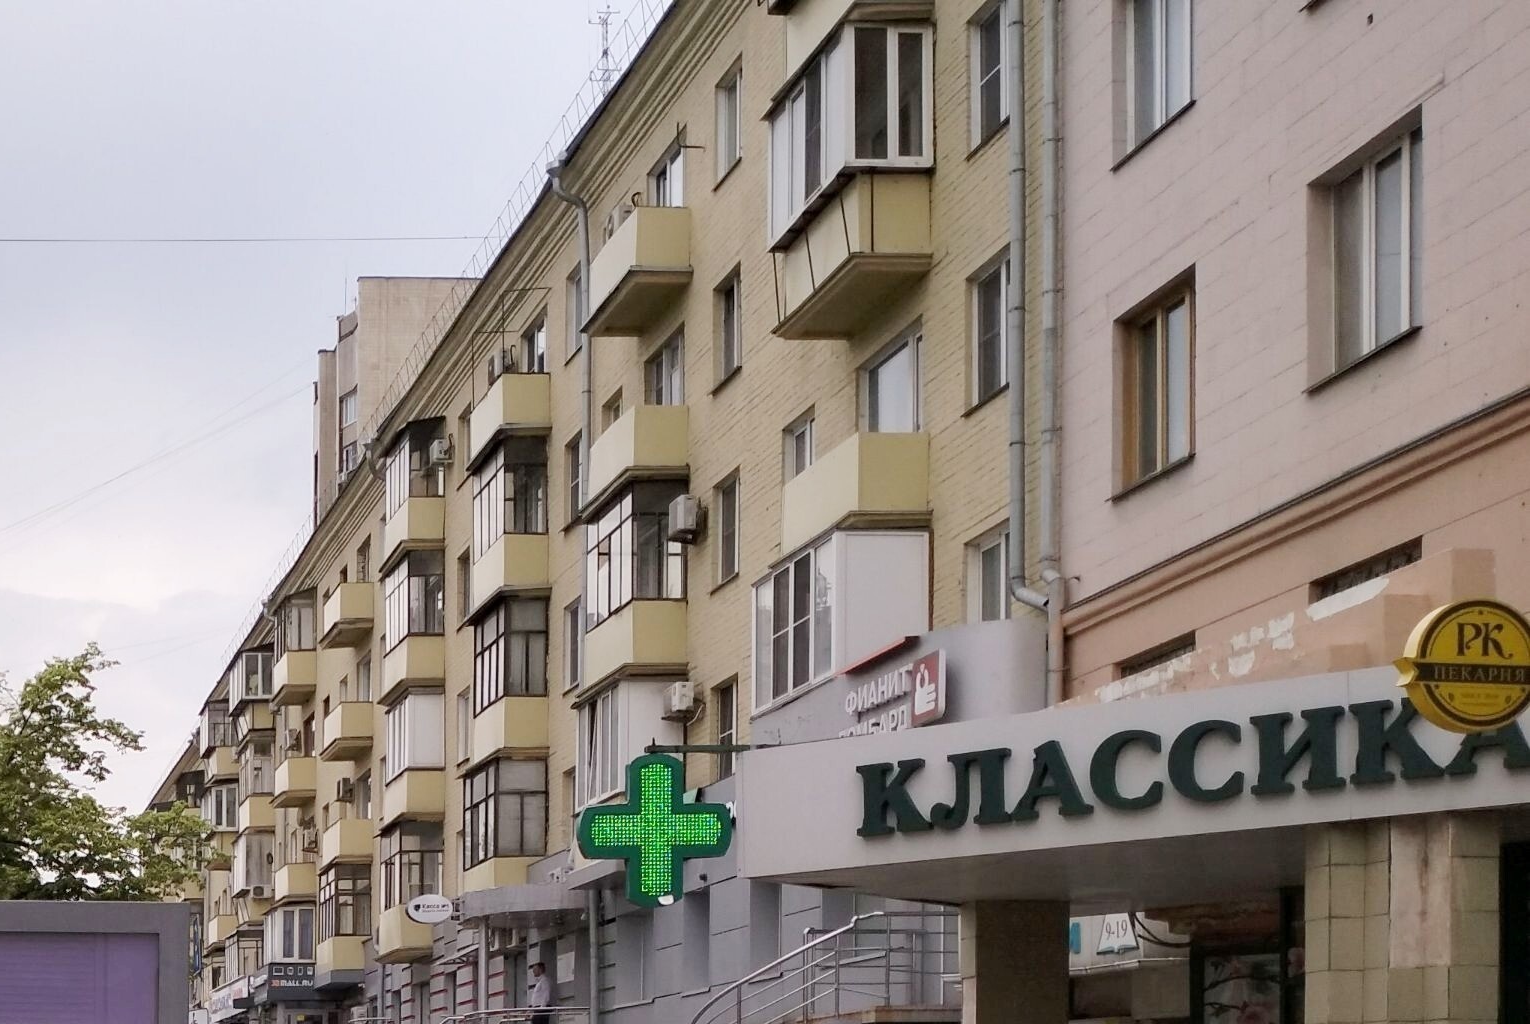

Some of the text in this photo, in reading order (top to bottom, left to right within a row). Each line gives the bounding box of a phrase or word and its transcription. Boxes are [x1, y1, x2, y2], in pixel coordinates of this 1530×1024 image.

[1433, 664, 1526, 682] ПЕКАРНЯ
[845, 663, 913, 716] ФИАНИТ
[1105, 919, 1128, 940] 9-19
